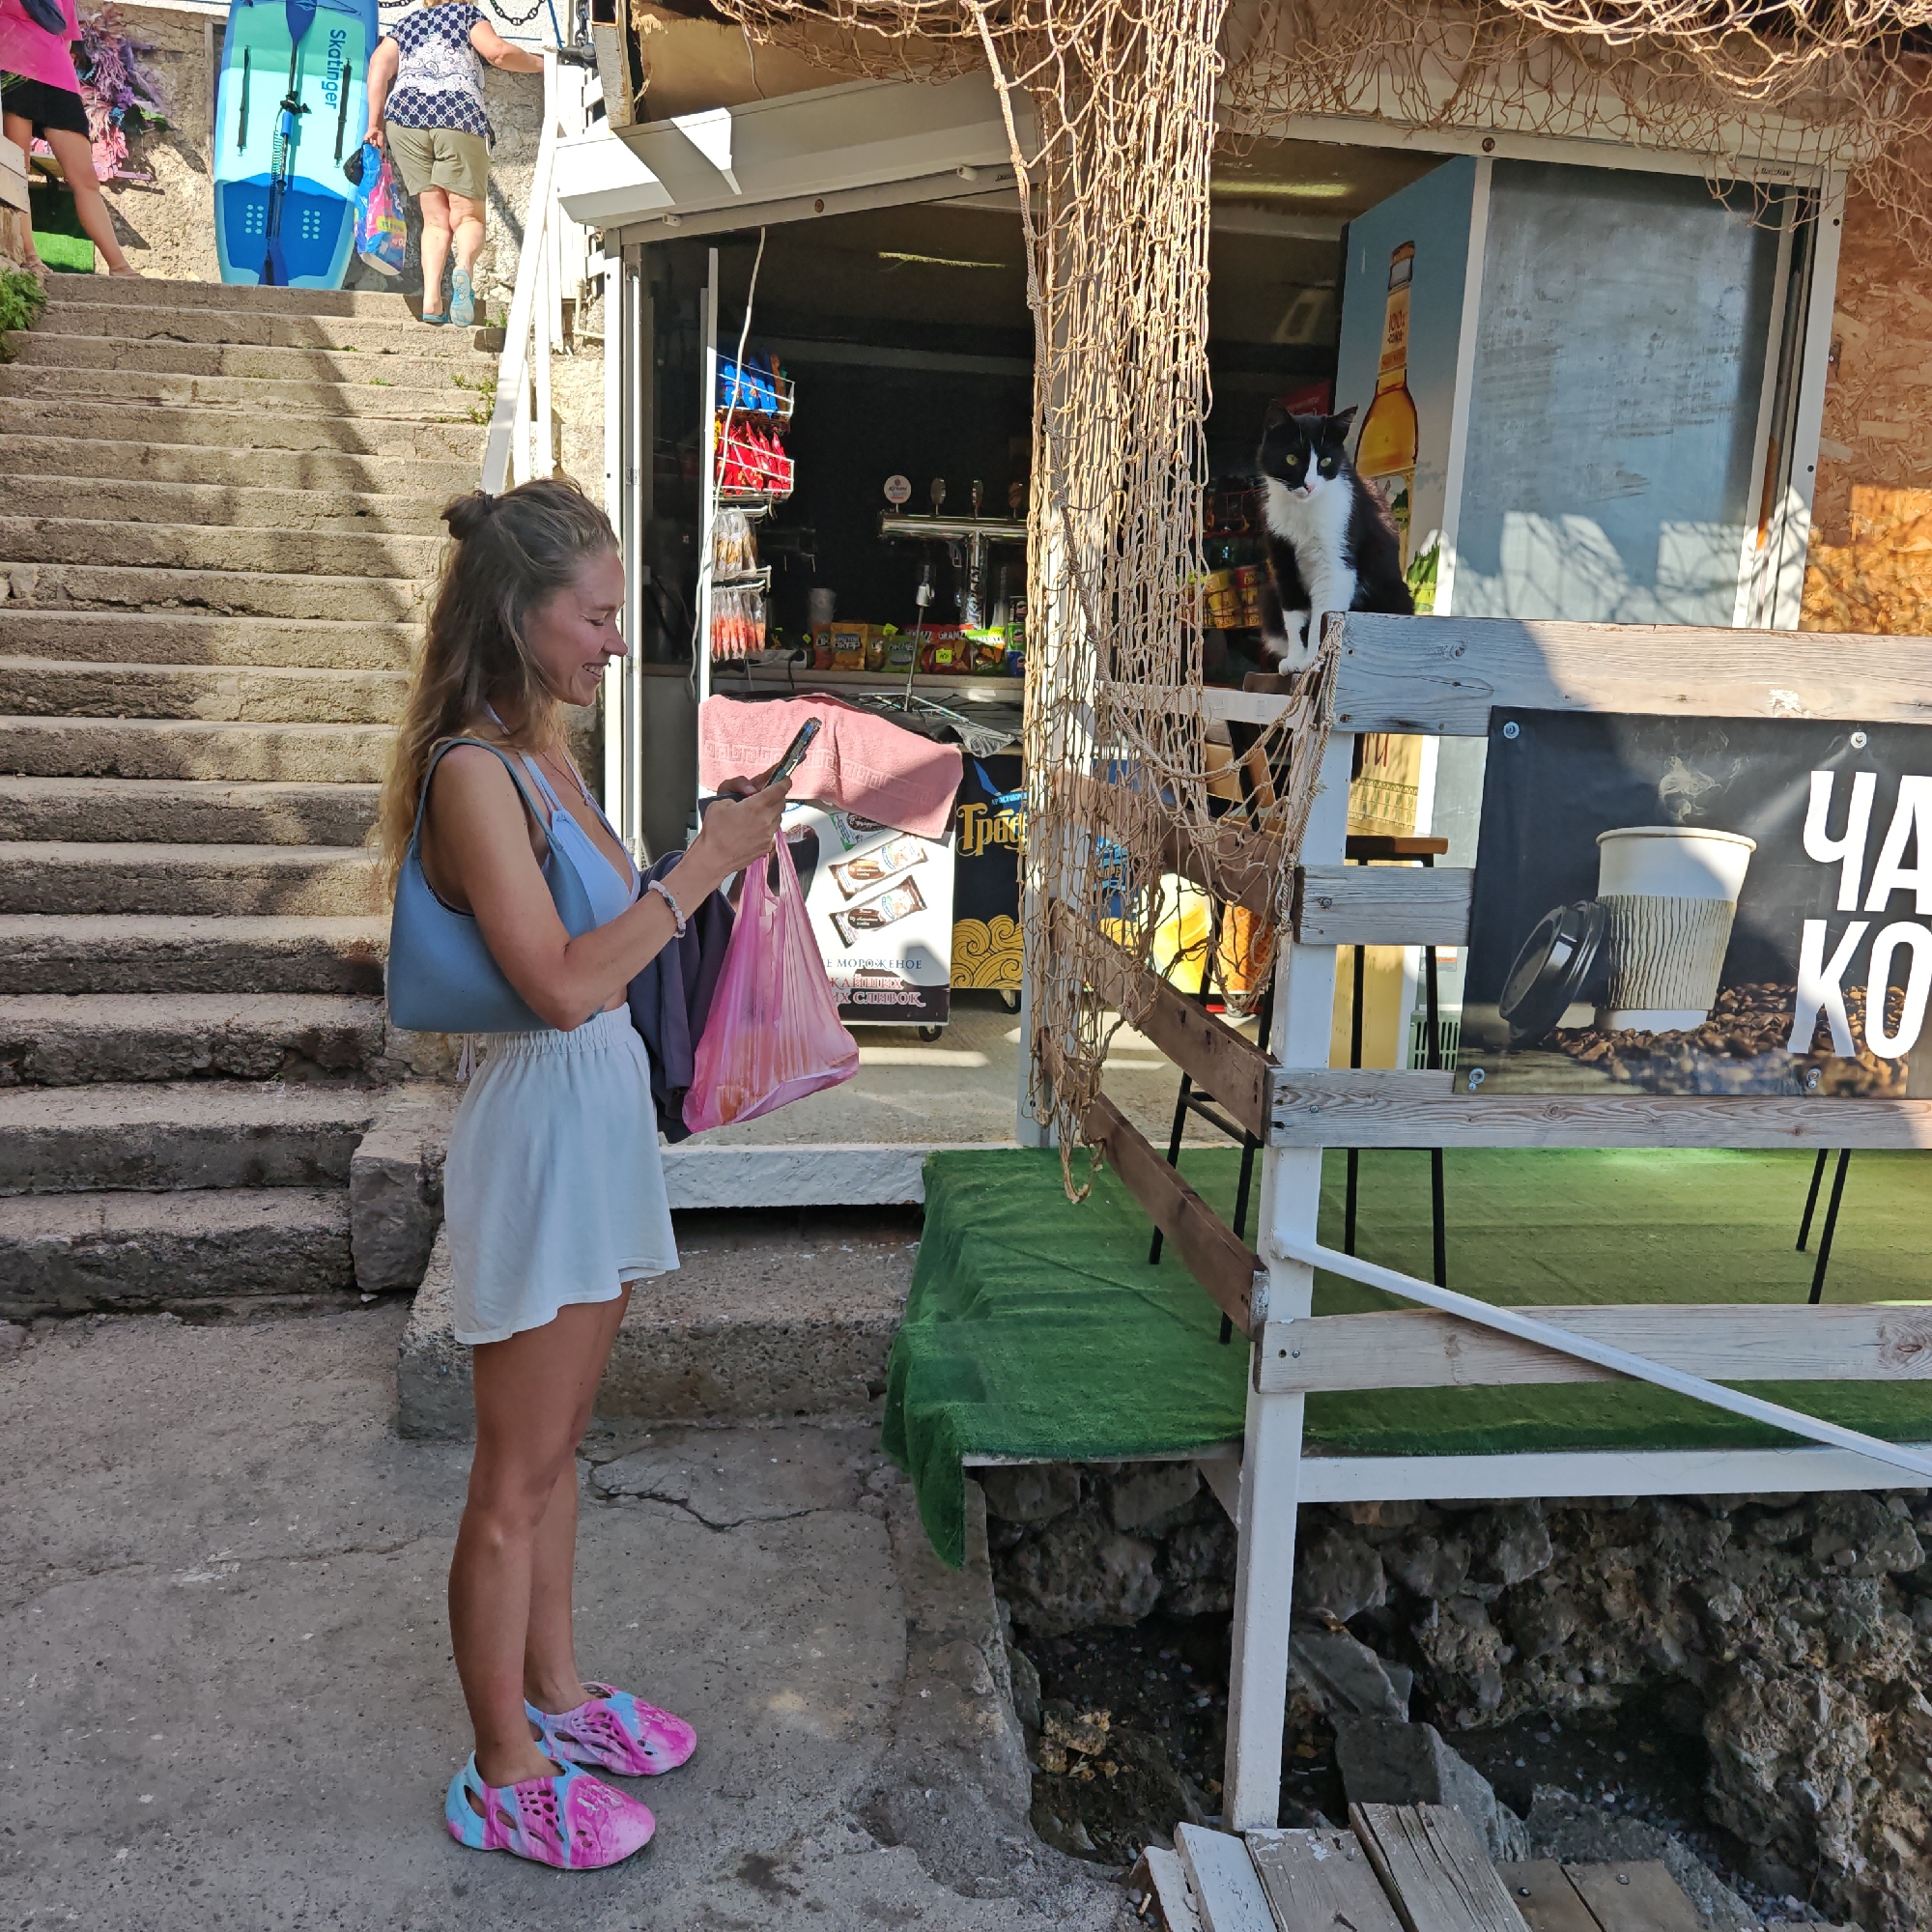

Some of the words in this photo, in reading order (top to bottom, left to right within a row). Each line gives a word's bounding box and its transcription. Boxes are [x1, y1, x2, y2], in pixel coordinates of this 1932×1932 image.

[322, 29, 346, 109] Skatinger
[1804, 770, 1932, 916] ЧА
[837, 958, 923, 970] МОРОЖЕНОЕ
[853, 992, 926, 1007] СЛИВОК
[1787, 919, 1932, 1060] КО
